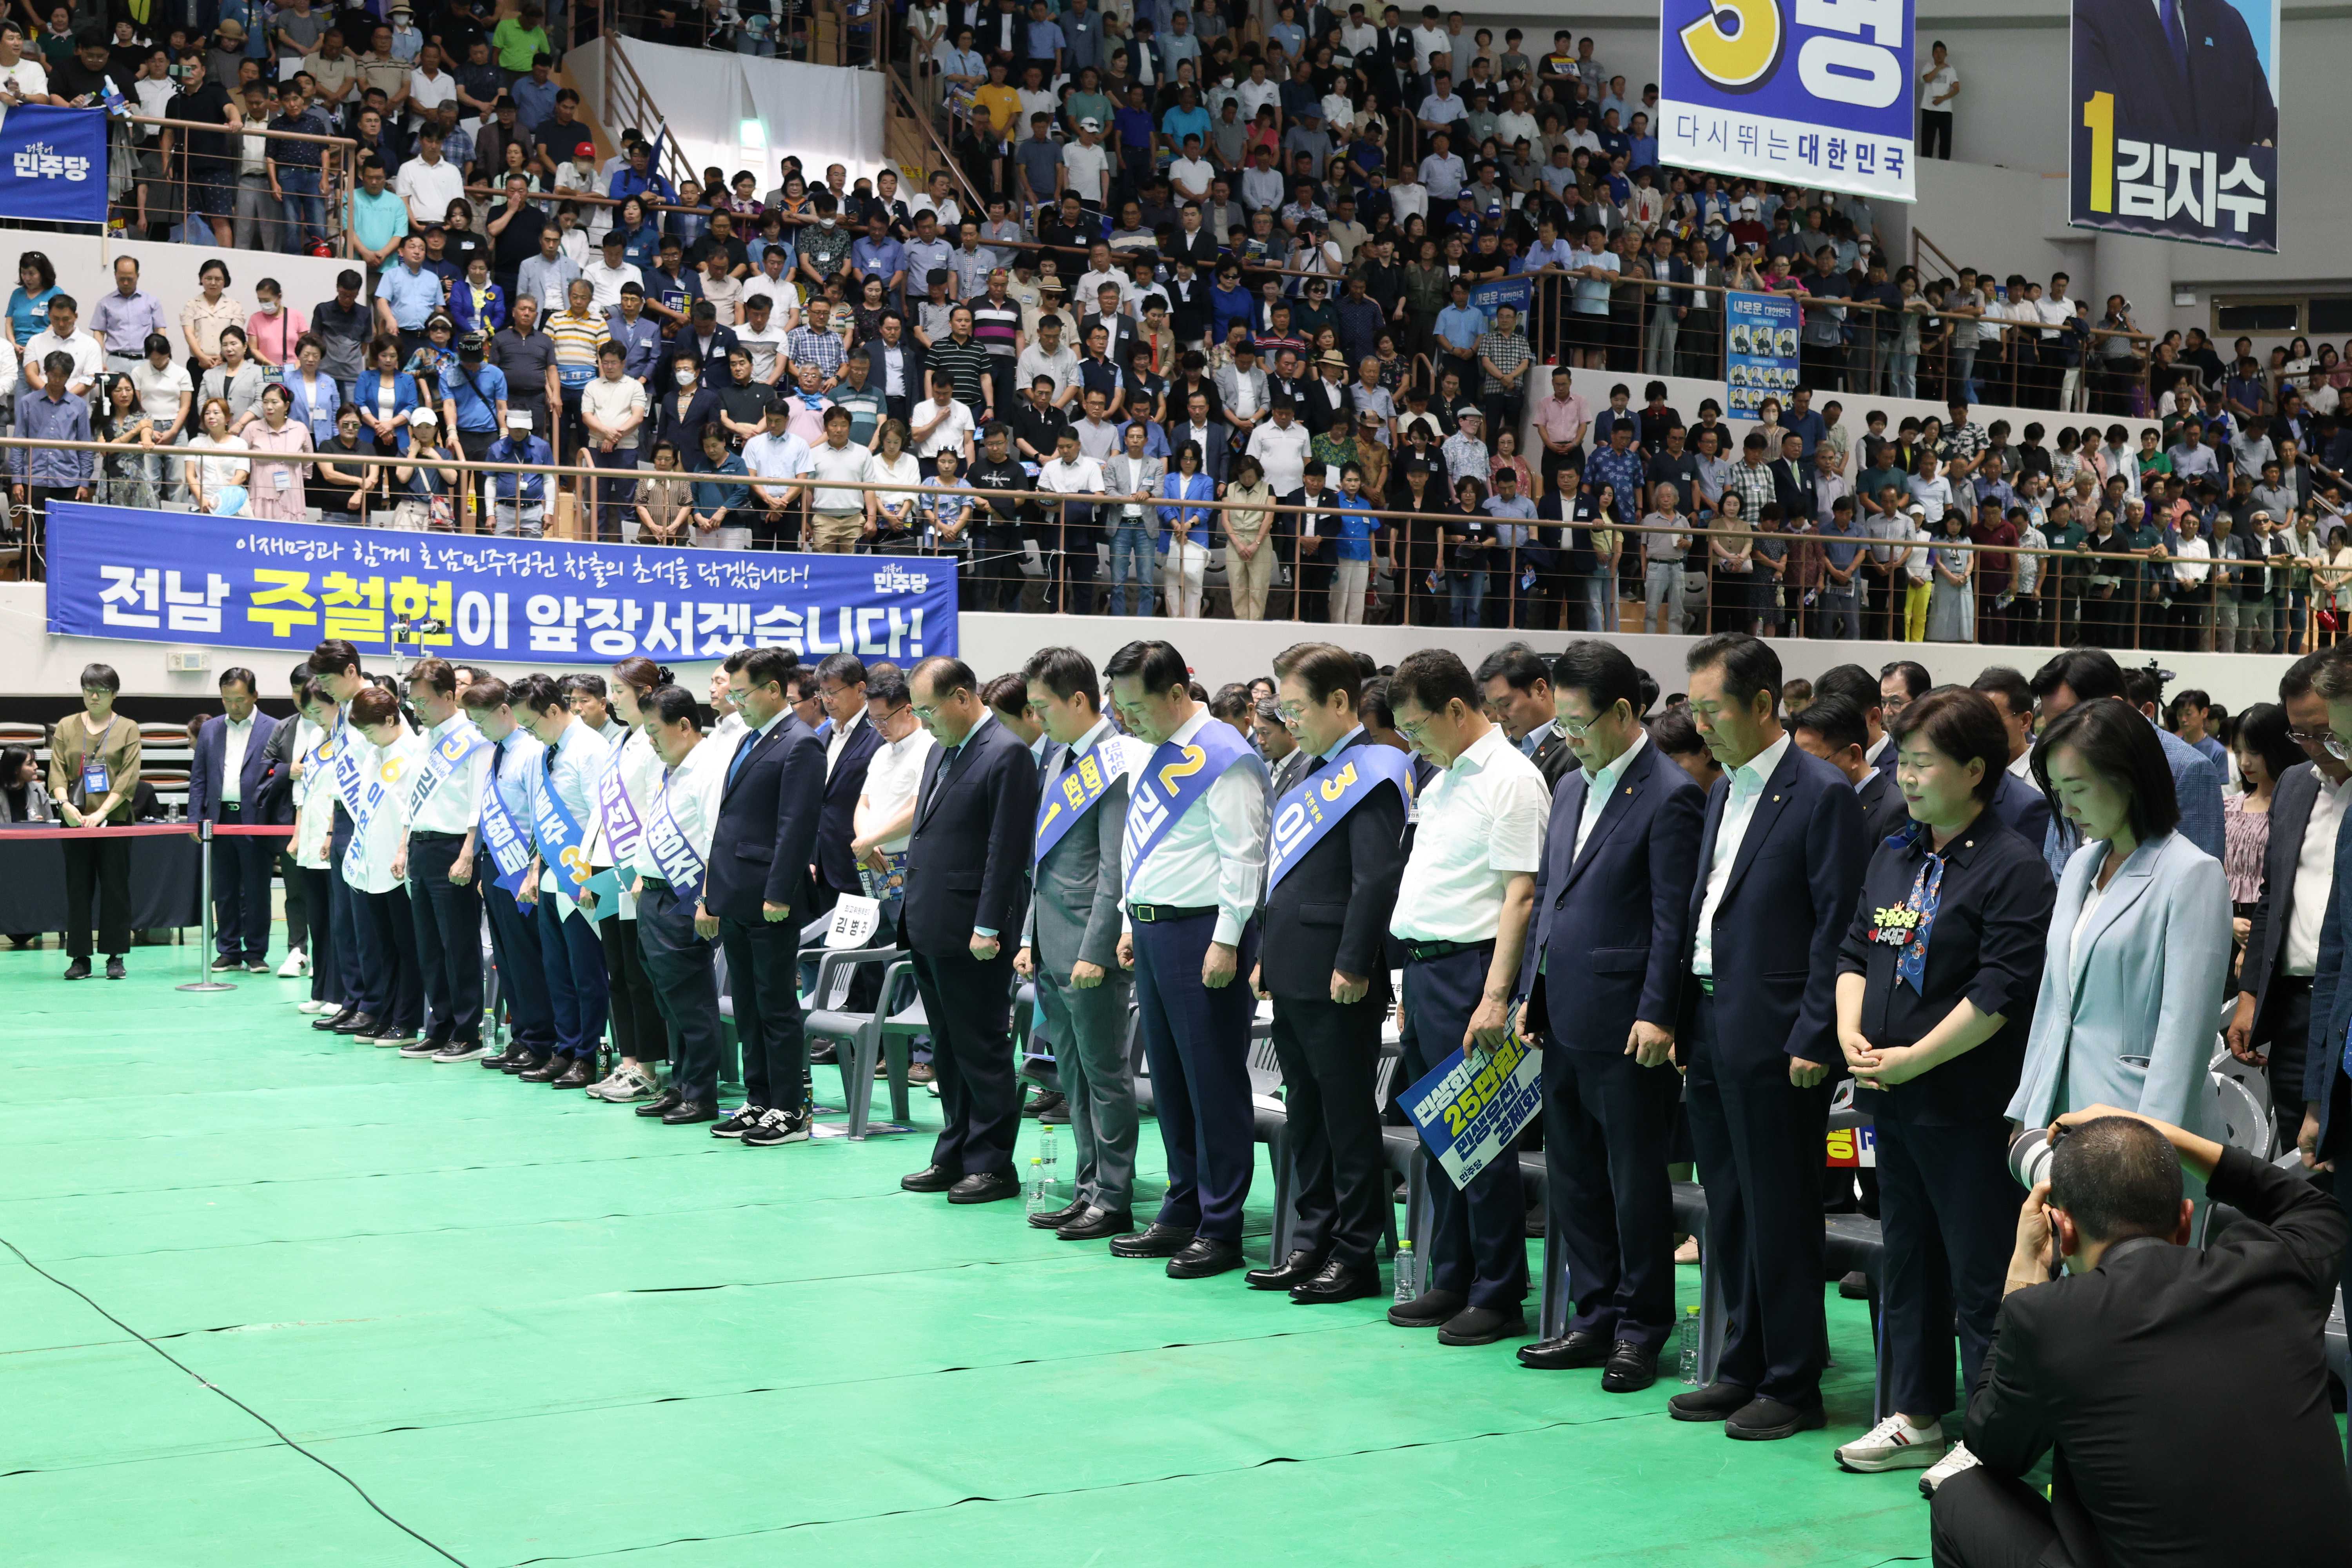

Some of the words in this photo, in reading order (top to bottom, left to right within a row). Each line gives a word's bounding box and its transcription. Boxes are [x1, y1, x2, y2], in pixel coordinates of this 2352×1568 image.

[14, 152, 90, 181] 민주당
[25, 141, 53, 156] 더불어
[1798, 134, 1904, 180] 대한민국
[2083, 91, 2114, 214] 1
[2117, 139, 2267, 233] 김지수
[1733, 300, 1762, 316] 새로운
[1764, 306, 1791, 318] 대한민국
[1752, 330, 1760, 345] 2
[1775, 333, 1782, 347] 3
[235, 534, 345, 561] 이재명과
[352, 540, 410, 567] 함께
[564, 551, 624, 588] 창출의
[632, 554, 693, 589] 초석을
[696, 561, 810, 590] 닦겠습니다!
[873, 572, 929, 595] 민주당
[98, 565, 230, 633] 전남
[247, 568, 509, 649] 주철현이
[525, 594, 924, 658] 앞장서겠습니다!
[442, 725, 483, 761] 5
[1104, 741, 1127, 775] 민주당
[380, 755, 401, 783] 6
[1078, 753, 1105, 799] 미래가
[1158, 744, 1207, 798] 2
[1320, 760, 1359, 802] 3
[408, 766, 438, 822] 김민
[1062, 773, 1087, 812] 온다!
[350, 781, 386, 861] 이언주
[482, 784, 529, 877] 민형배
[1038, 802, 1062, 839] 1
[1443, 1031, 1526, 1138] 25만원!
[1454, 1073, 1523, 1163] 민생우선!
[1459, 1159, 1483, 1184] 민주당
